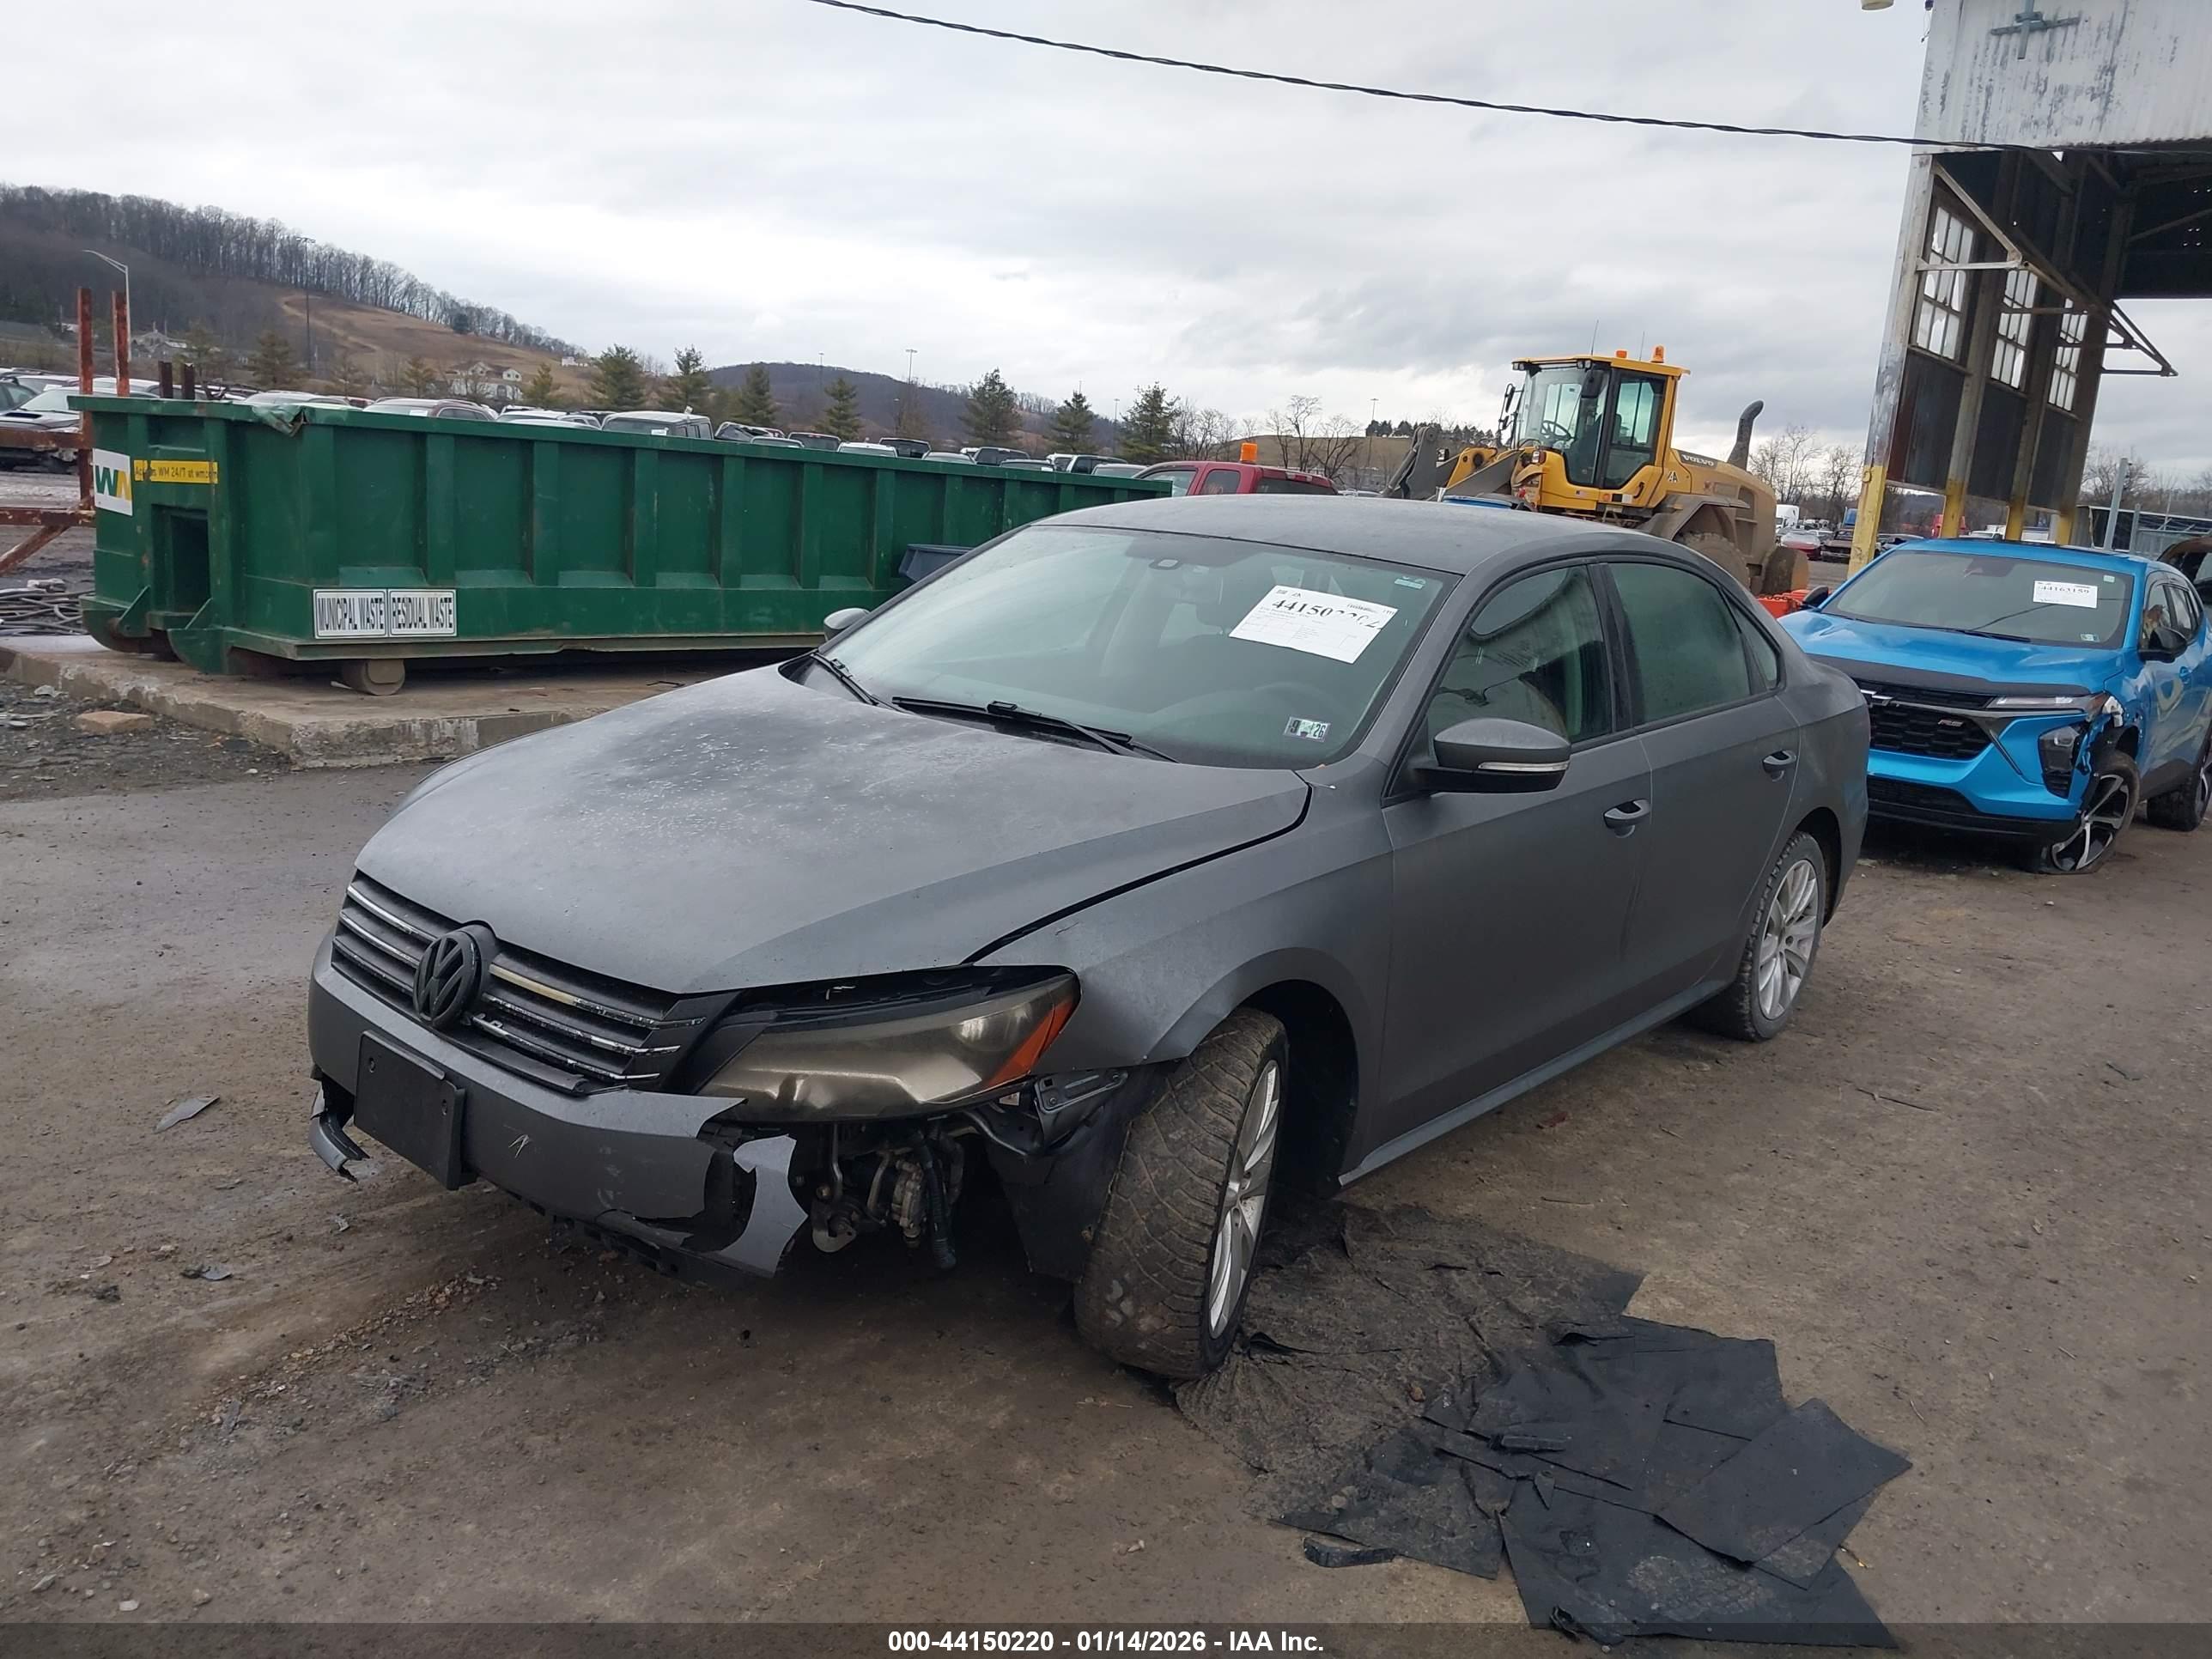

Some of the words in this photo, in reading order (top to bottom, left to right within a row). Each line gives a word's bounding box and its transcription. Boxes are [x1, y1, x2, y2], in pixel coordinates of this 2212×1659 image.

[1681, 454, 1714, 466] VOLVO
[318, 598, 358, 630] MUNICIPAL
[359, 598, 384, 629] WASTE
[392, 597, 427, 629] RESIDUAL
[428, 597, 453, 629] WASTE
[1313, 723, 1326, 738] 26
